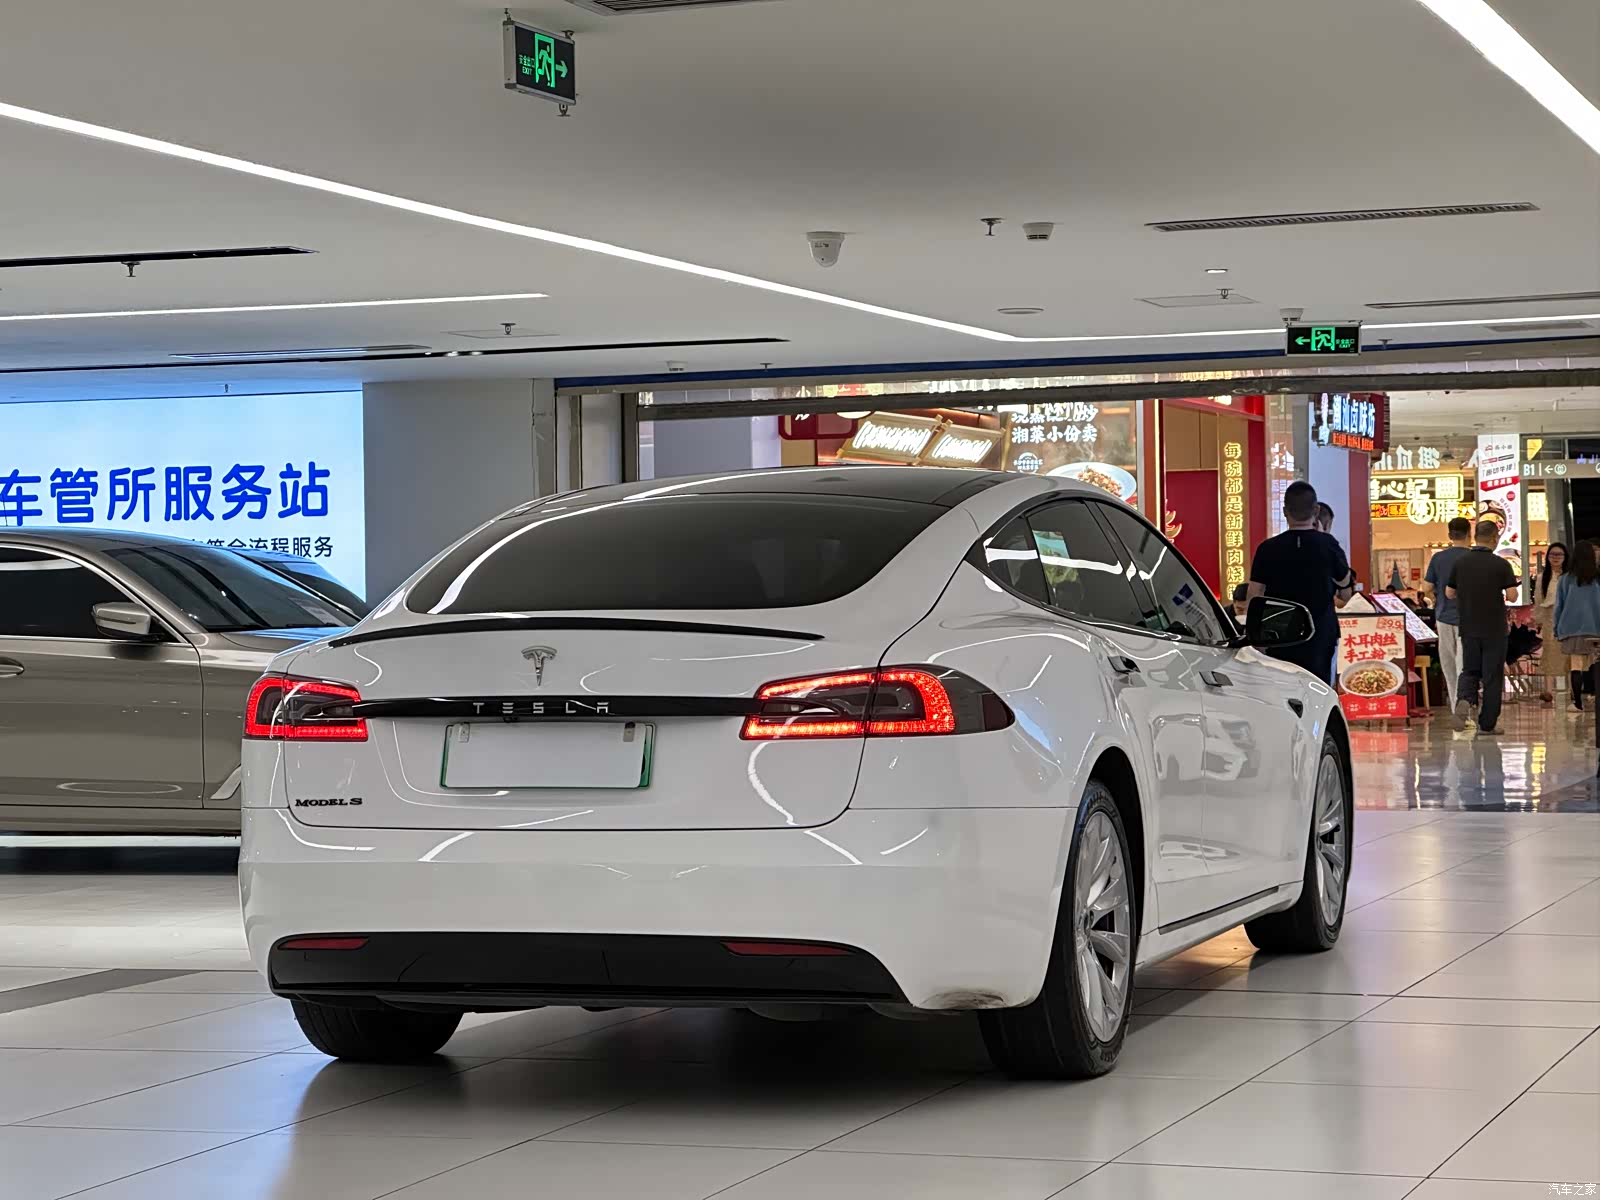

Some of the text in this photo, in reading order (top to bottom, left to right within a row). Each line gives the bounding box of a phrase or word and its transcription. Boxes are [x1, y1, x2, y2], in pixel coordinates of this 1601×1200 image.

[522, 66, 533, 75] EXIT
[1012, 423, 1097, 443] 湘菜小份卖
[1523, 464, 1535, 477] B1
[0, 460, 330, 526] 车管所服务站
[1344, 632, 1398, 648] 木耳肉丝
[1344, 648, 1386, 663] 手工粉
[473, 702, 609, 714] TESLA
[295, 798, 363, 807] MODEL S
